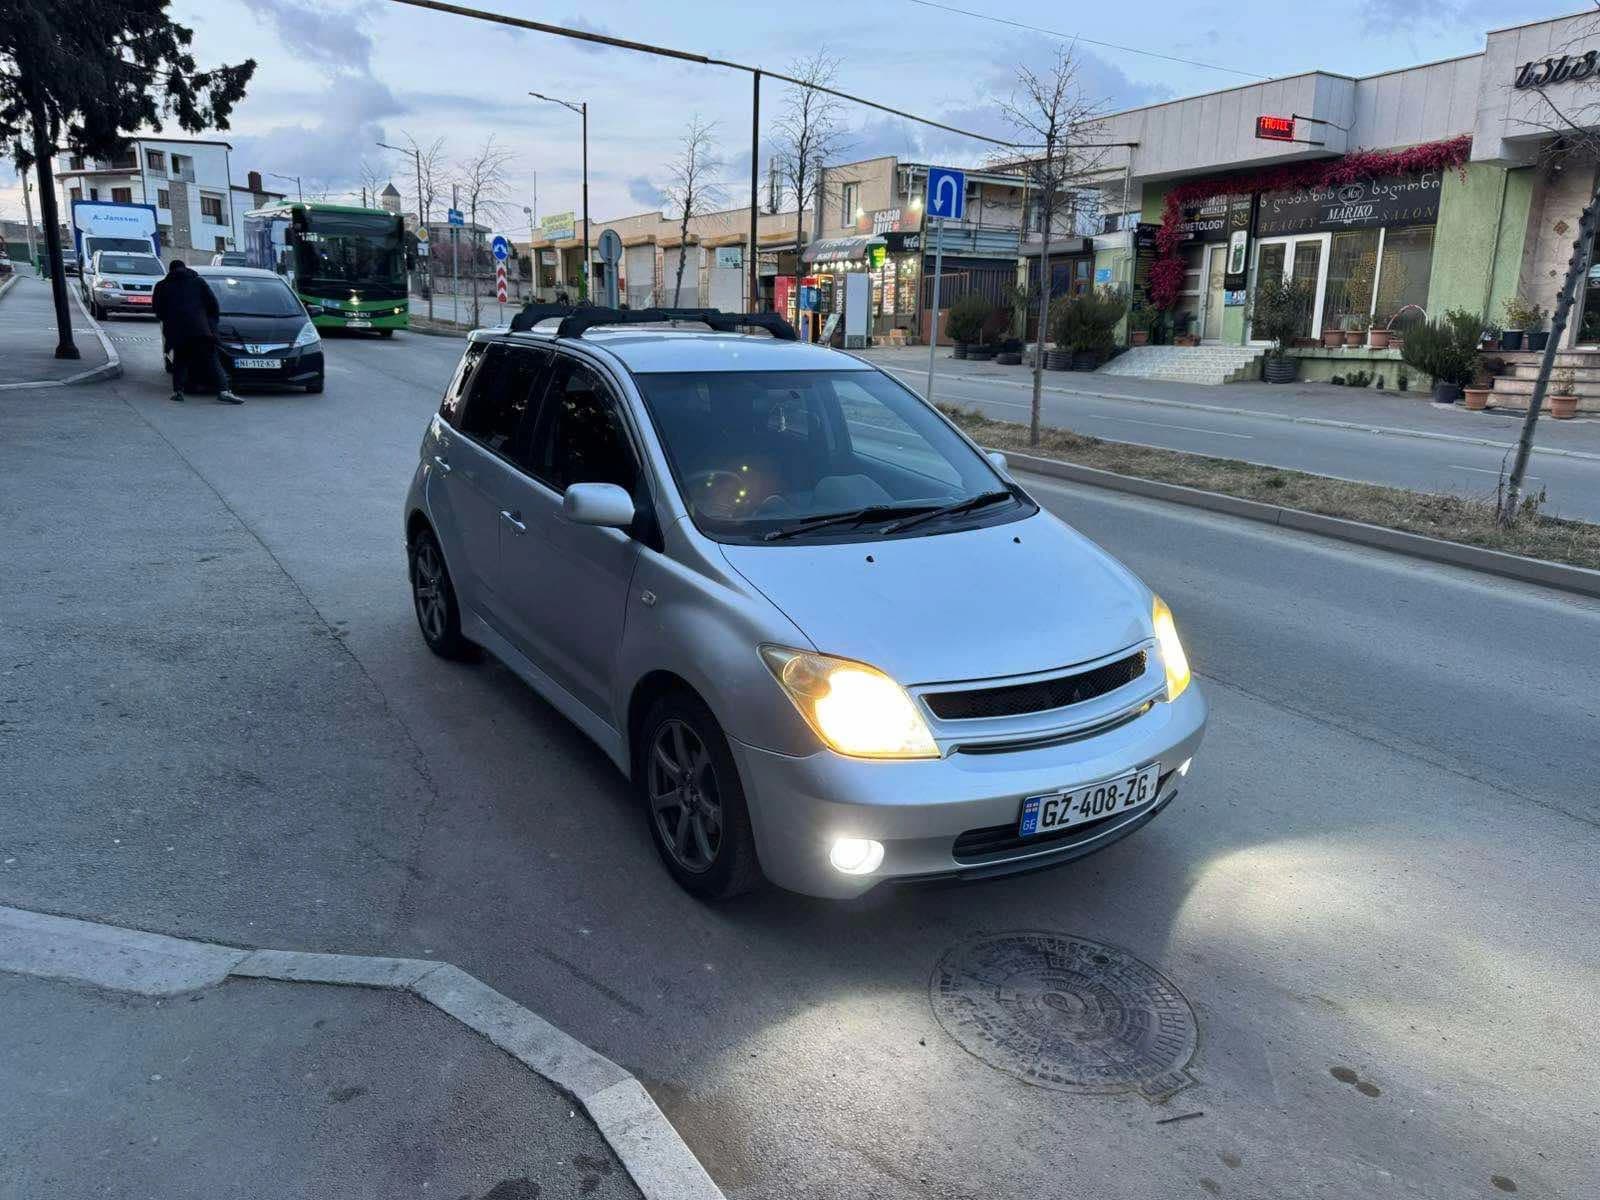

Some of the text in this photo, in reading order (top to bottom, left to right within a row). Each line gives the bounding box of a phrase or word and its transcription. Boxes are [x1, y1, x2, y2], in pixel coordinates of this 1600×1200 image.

[1264, 118, 1290, 131] HOTEL
[1372, 173, 1441, 201] სალონი
[1327, 204, 1373, 220] MARIKO
[1382, 206, 1436, 221] SALON
[1041, 773, 1148, 828] GZ-408-ZG
[1023, 818, 1036, 831] GE
